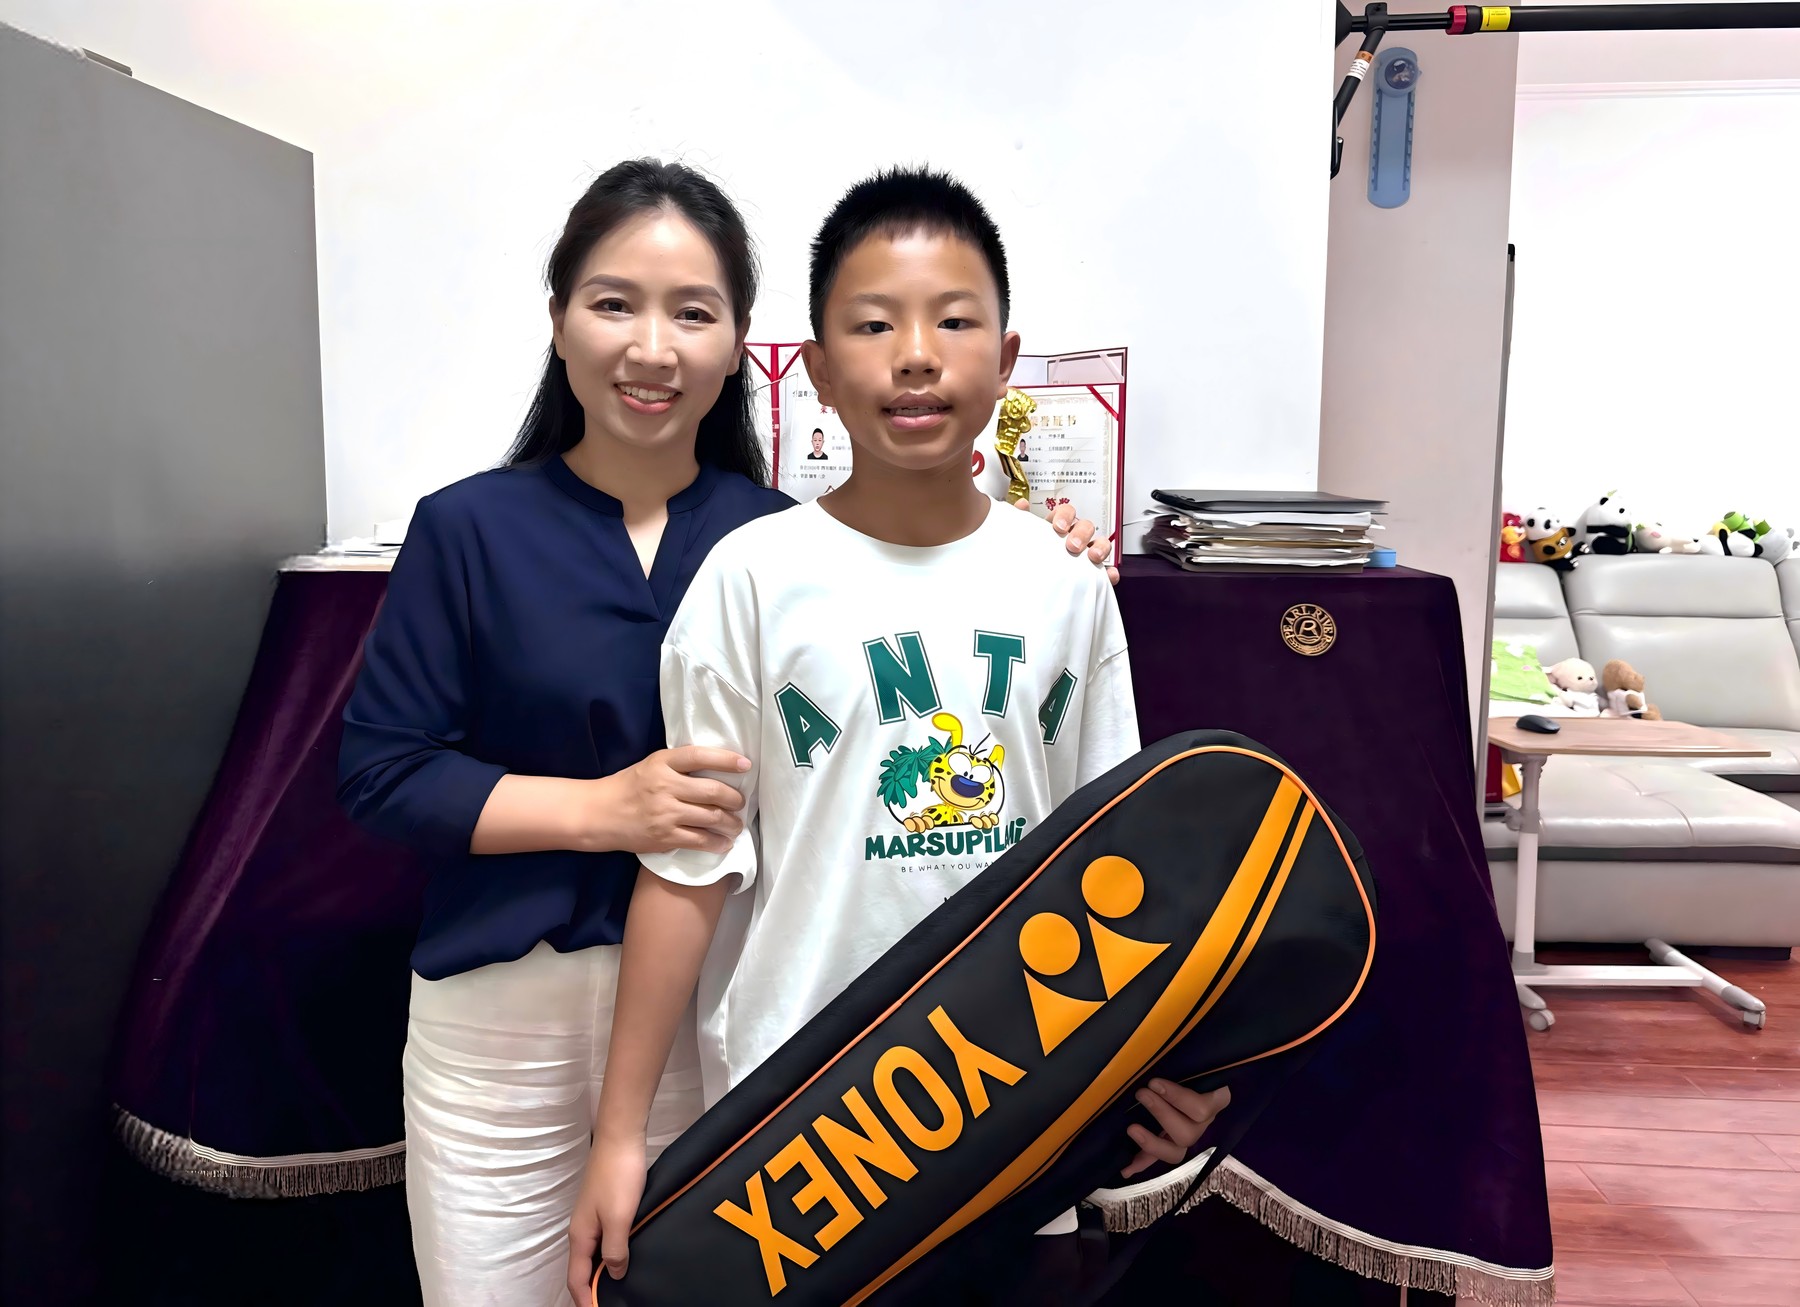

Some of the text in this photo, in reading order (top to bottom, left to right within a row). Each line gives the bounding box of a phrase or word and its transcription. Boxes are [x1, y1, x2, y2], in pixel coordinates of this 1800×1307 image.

[1283, 606, 1334, 643] PEARL RIVER
[918, 863, 947, 872] WHAT
[950, 862, 971, 870] YOU
[975, 861, 995, 869] WA
[713, 1005, 1028, 1298] YONEX
